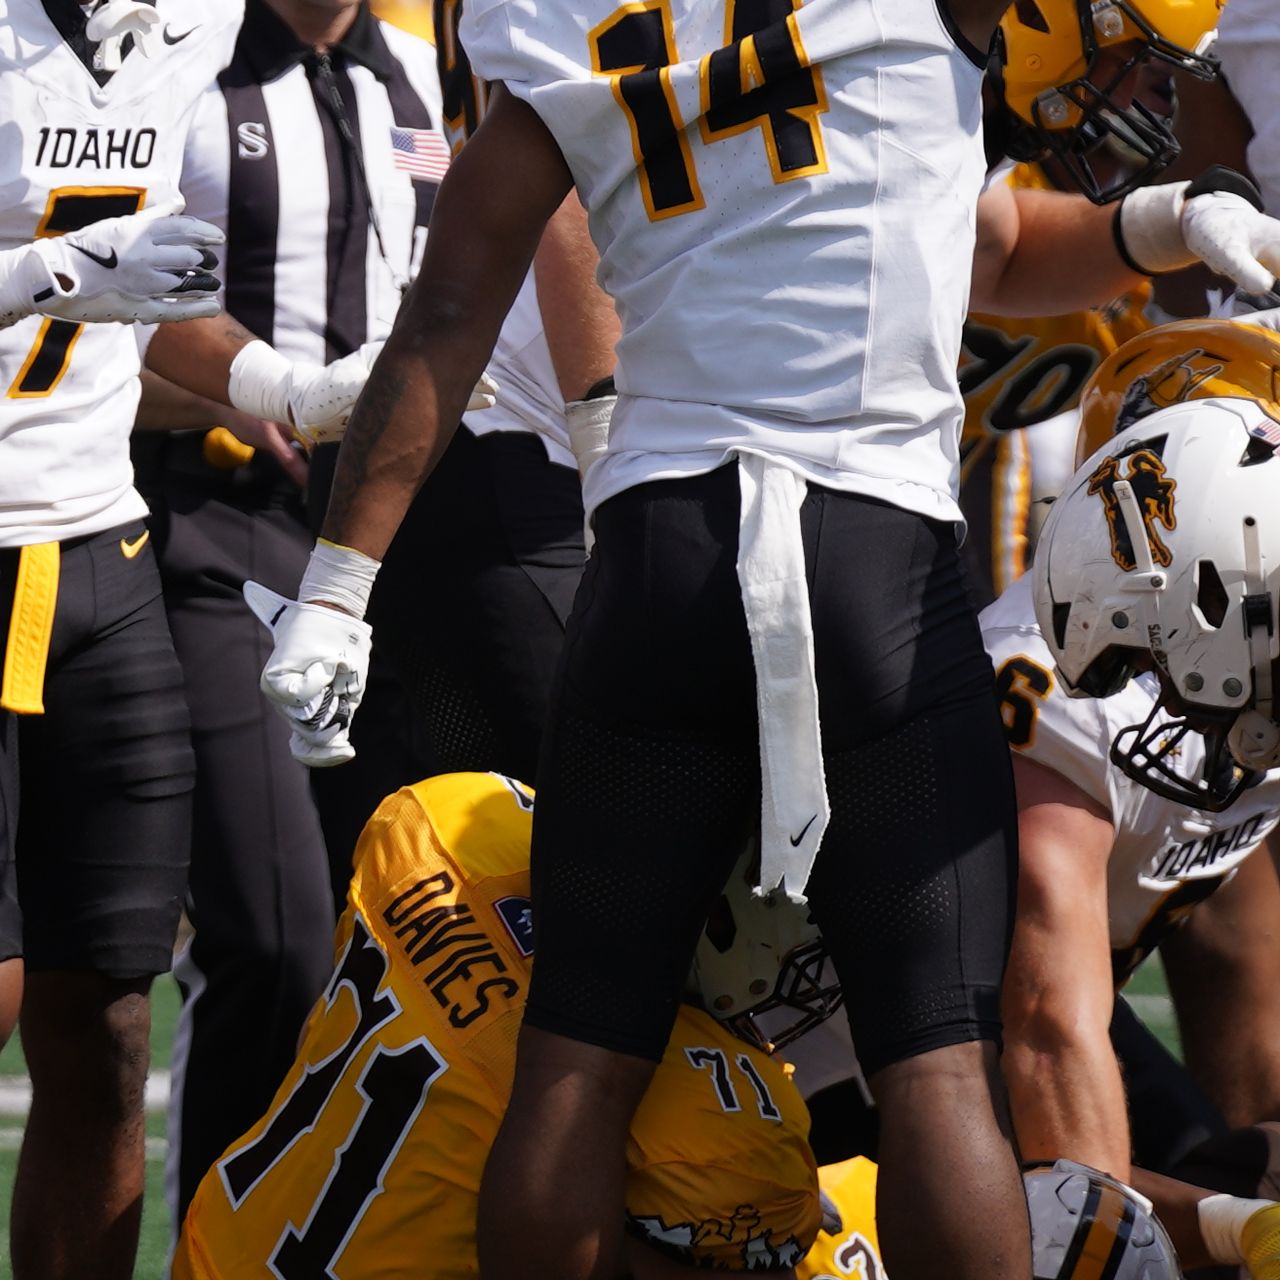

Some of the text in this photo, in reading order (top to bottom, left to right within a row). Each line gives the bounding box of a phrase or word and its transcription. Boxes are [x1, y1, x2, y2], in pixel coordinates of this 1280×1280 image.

[34, 126, 158, 170] IDAHO
[236, 121, 271, 160] S
[5, 185, 148, 400] 7
[1152, 811, 1266, 879] IDAHO
[382, 870, 520, 1029] DAVIES
[216, 912, 450, 1280] 71
[684, 1046, 783, 1123] 71
